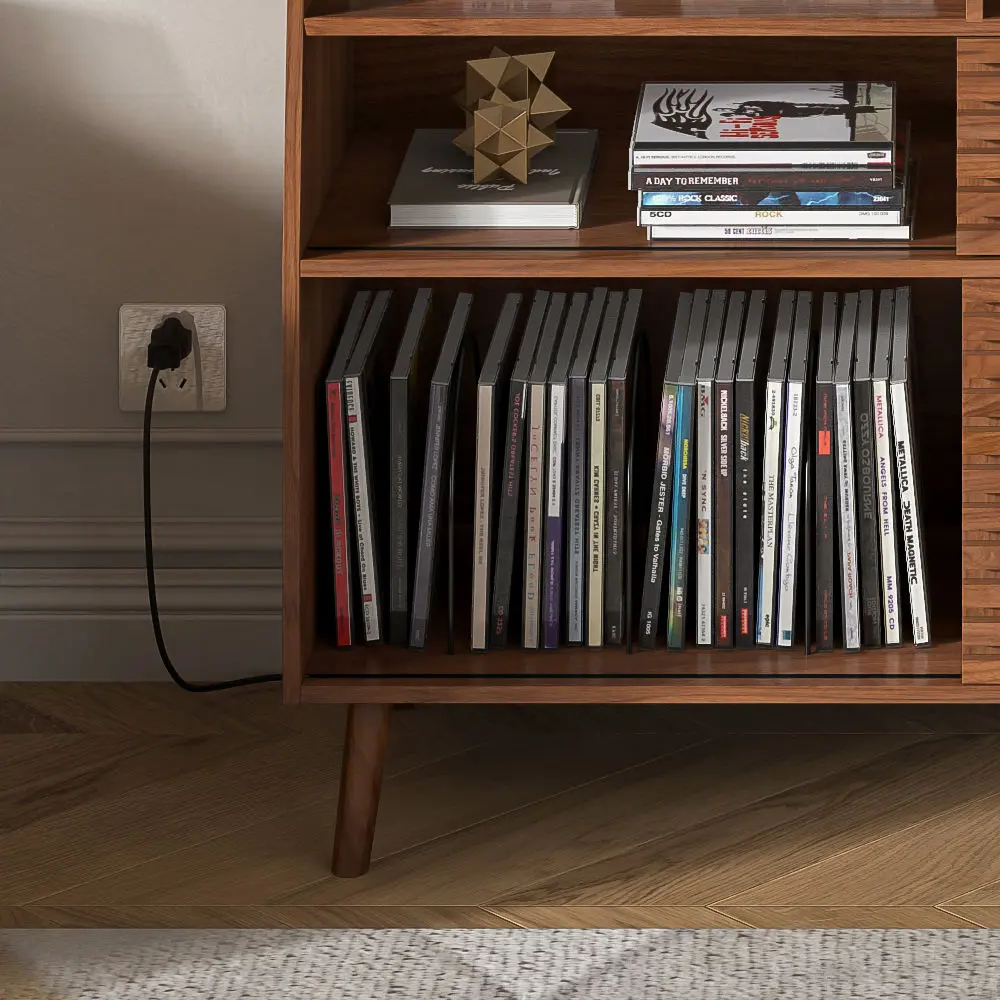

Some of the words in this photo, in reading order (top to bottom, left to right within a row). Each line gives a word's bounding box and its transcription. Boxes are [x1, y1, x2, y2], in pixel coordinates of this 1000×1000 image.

[646, 178, 653, 186] A
[654, 178, 672, 186] DAY
[675, 178, 687, 186] TO
[688, 178, 738, 186] REMEMBER
[680, 195, 701, 203] ROCK
[704, 195, 738, 203] CLASSIC
[660, 446, 669, 479] MORBID
[787, 446, 797, 469] Olga
[897, 440, 908, 492] METALLICA
[720, 468, 727, 476] UP
[656, 481, 666, 512] JESTER
[765, 493, 774, 547] MASTERPLAN
[902, 500, 912, 532] DEATH
[654, 519, 663, 541] Gates
[653, 543, 660, 551] to
[649, 553, 659, 582] Valhalla
[906, 535, 917, 585] MAGNETIC
[886, 575, 892, 590] MM
[888, 617, 894, 630] CD
